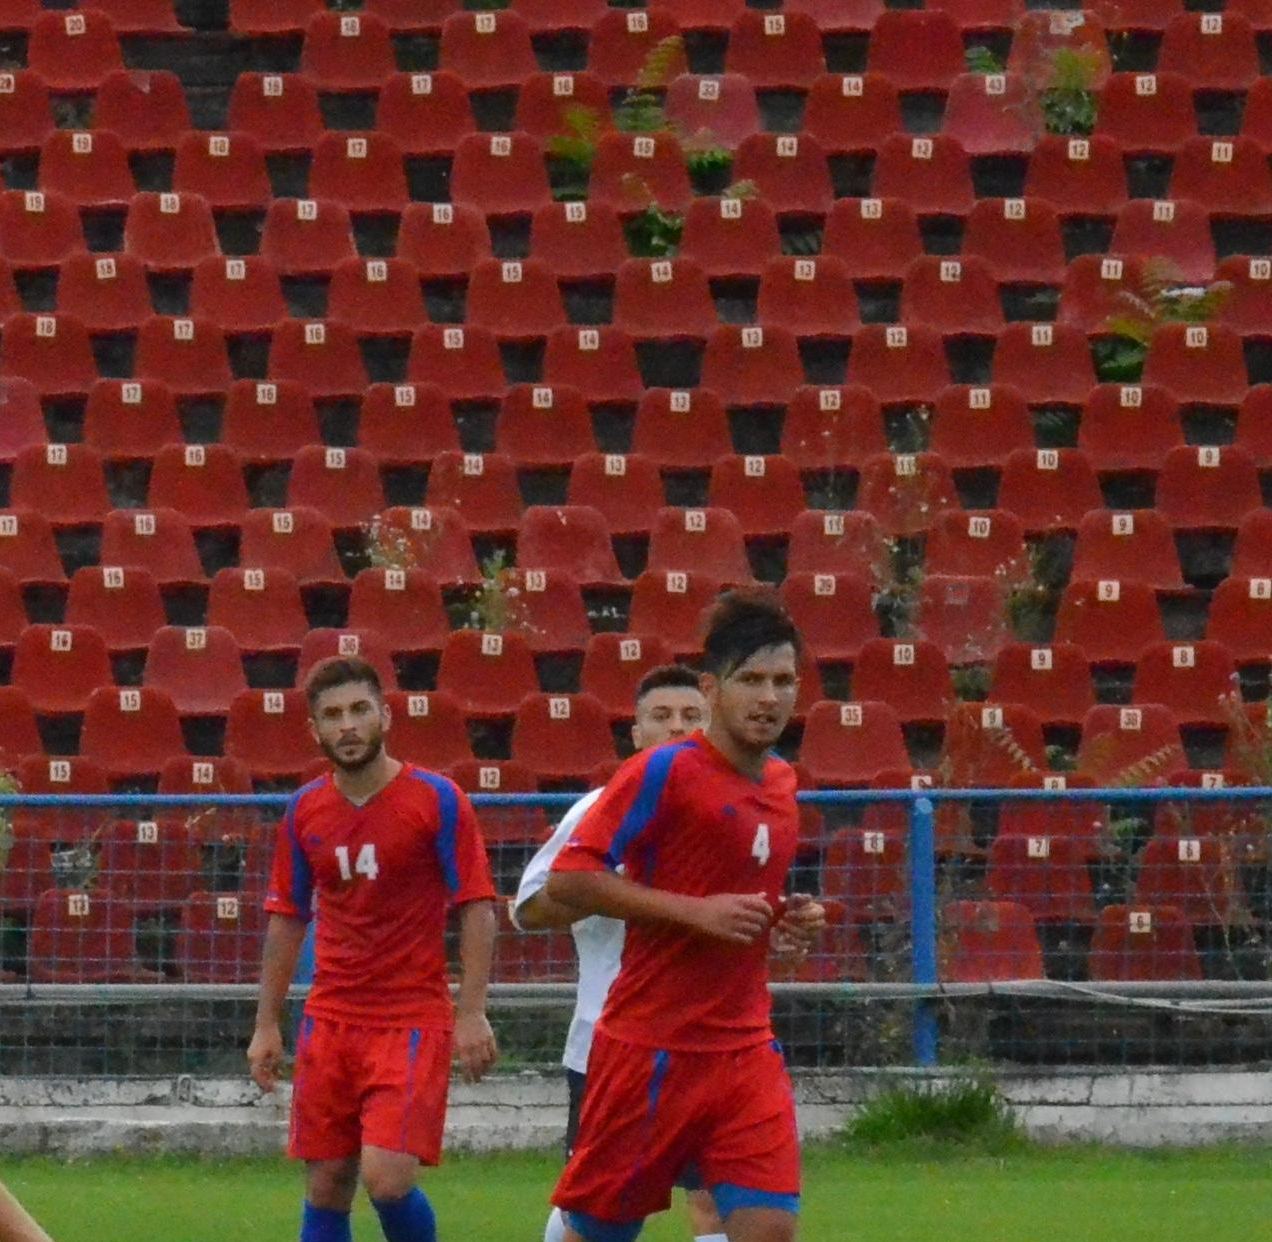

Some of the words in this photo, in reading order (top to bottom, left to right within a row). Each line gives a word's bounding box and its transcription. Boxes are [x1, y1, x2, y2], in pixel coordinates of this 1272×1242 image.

[1072, 143, 1086, 158] 12
[1216, 146, 1229, 159] 11
[725, 202, 739, 216] 14
[1009, 202, 1023, 218] 12
[371, 264, 385, 278] 16
[506, 265, 520, 281] 15
[655, 265, 670, 279] 14
[799, 263, 813, 278] 13
[1106, 263, 1119, 277] 11
[40, 320, 54, 335] 18
[309, 327, 323, 342] 16
[582, 333, 597, 347] 14
[746, 331, 760, 345] 13
[890, 330, 904, 344] 12
[1190, 330, 1205, 345] 10
[260, 387, 275, 402] 16
[1041, 453, 1056, 468] 10
[1204, 449, 1214, 465] 9
[748, 459, 763, 475] 12
[1, 518, 14, 533] 17
[973, 520, 988, 535] 10
[1119, 517, 1128, 532] 9
[671, 575, 685, 591] 12
[1104, 583, 1114, 599] 9
[624, 642, 638, 658] 12
[1179, 649, 1189, 666] 8
[1037, 652, 1047, 667] 9
[124, 693, 138, 709] 15
[412, 698, 425, 714] 13
[553, 701, 568, 716] 12
[54, 764, 68, 780] 15
[141, 825, 155, 841] 13
[752, 823, 771, 866] 4
[1035, 840, 1047, 855] 7
[335, 843, 379, 881] 14
[1136, 915, 1144, 930] 6
